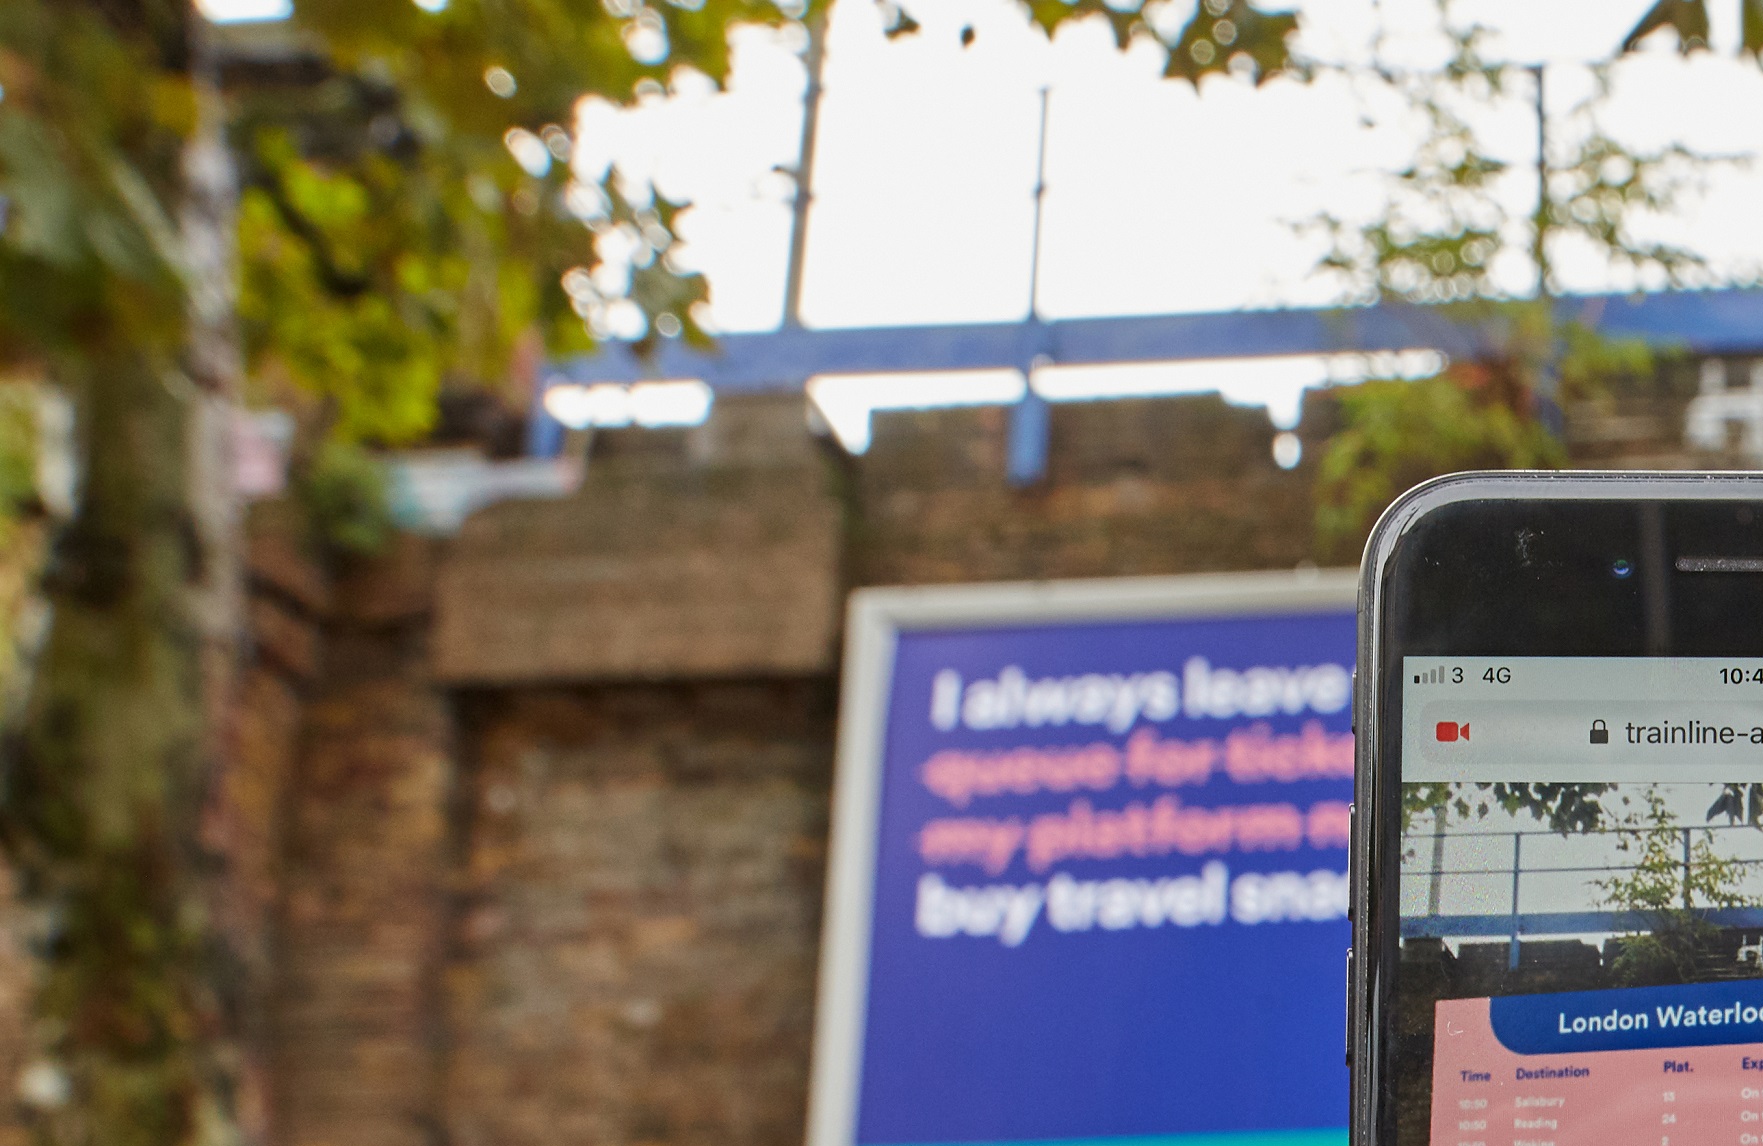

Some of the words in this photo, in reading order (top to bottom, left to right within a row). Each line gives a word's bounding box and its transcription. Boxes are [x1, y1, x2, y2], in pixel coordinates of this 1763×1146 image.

[1452, 667, 1463, 683] 3
[1483, 667, 1511, 684] 4G
[962, 665, 1179, 733] always
[1183, 656, 1351, 719] leave
[914, 872, 1043, 948] buy
[1047, 860, 1230, 933] travel
[1559, 1009, 1648, 1033] London
[1460, 1070, 1491, 1082] Time
[1516, 1066, 1590, 1080] Destination
[1664, 1061, 1693, 1073] Plat.
[1741, 1088, 1759, 1099] On
[1741, 1111, 1758, 1122] On
[1740, 1134, 1758, 1145] On
